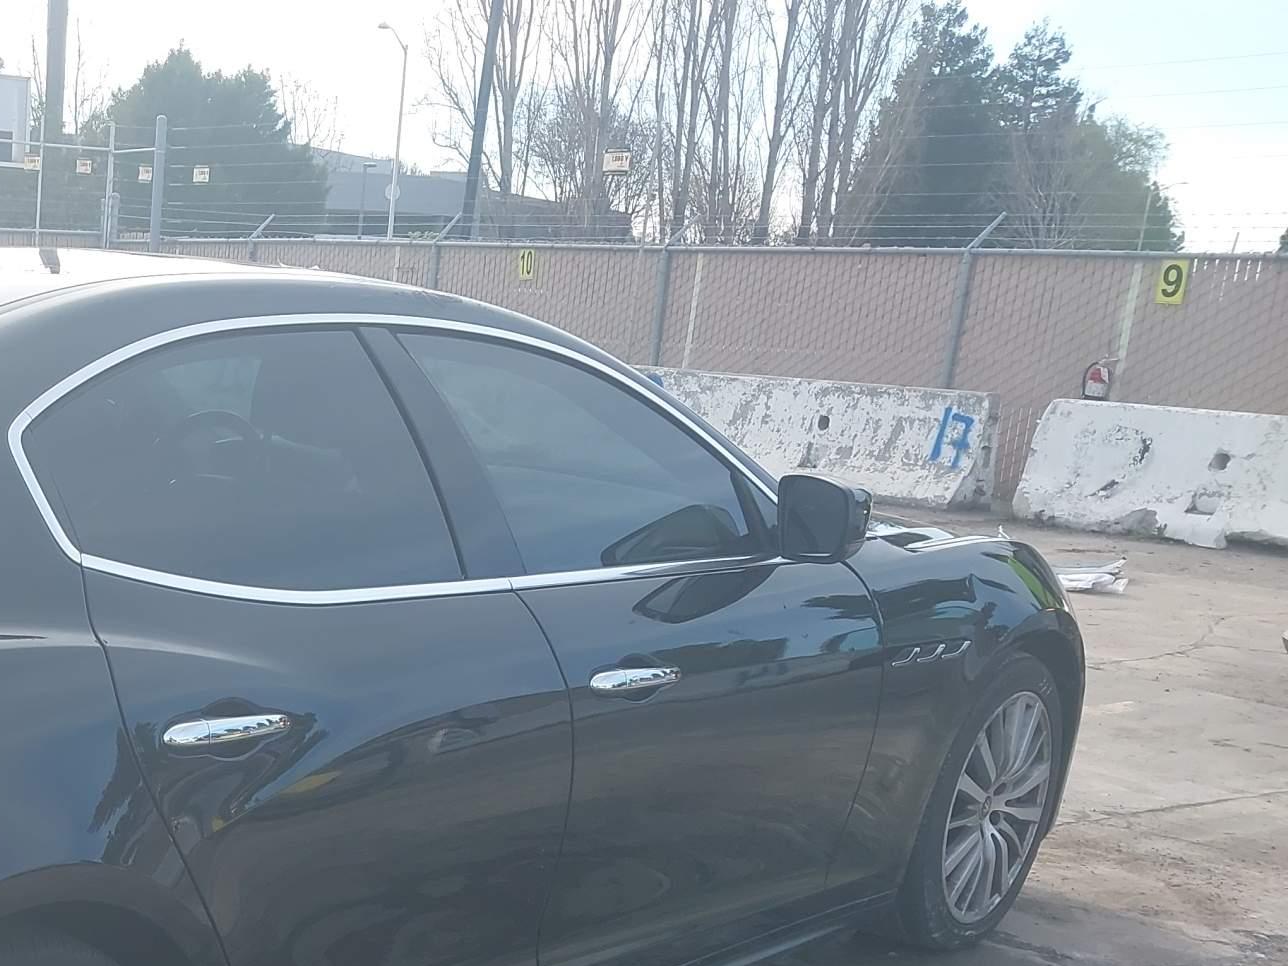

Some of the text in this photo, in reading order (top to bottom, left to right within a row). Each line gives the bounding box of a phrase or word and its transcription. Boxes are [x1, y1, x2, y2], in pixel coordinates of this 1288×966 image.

[520, 250, 533, 276] 10
[1161, 263, 1183, 298] 9
[929, 406, 975, 469] 17
